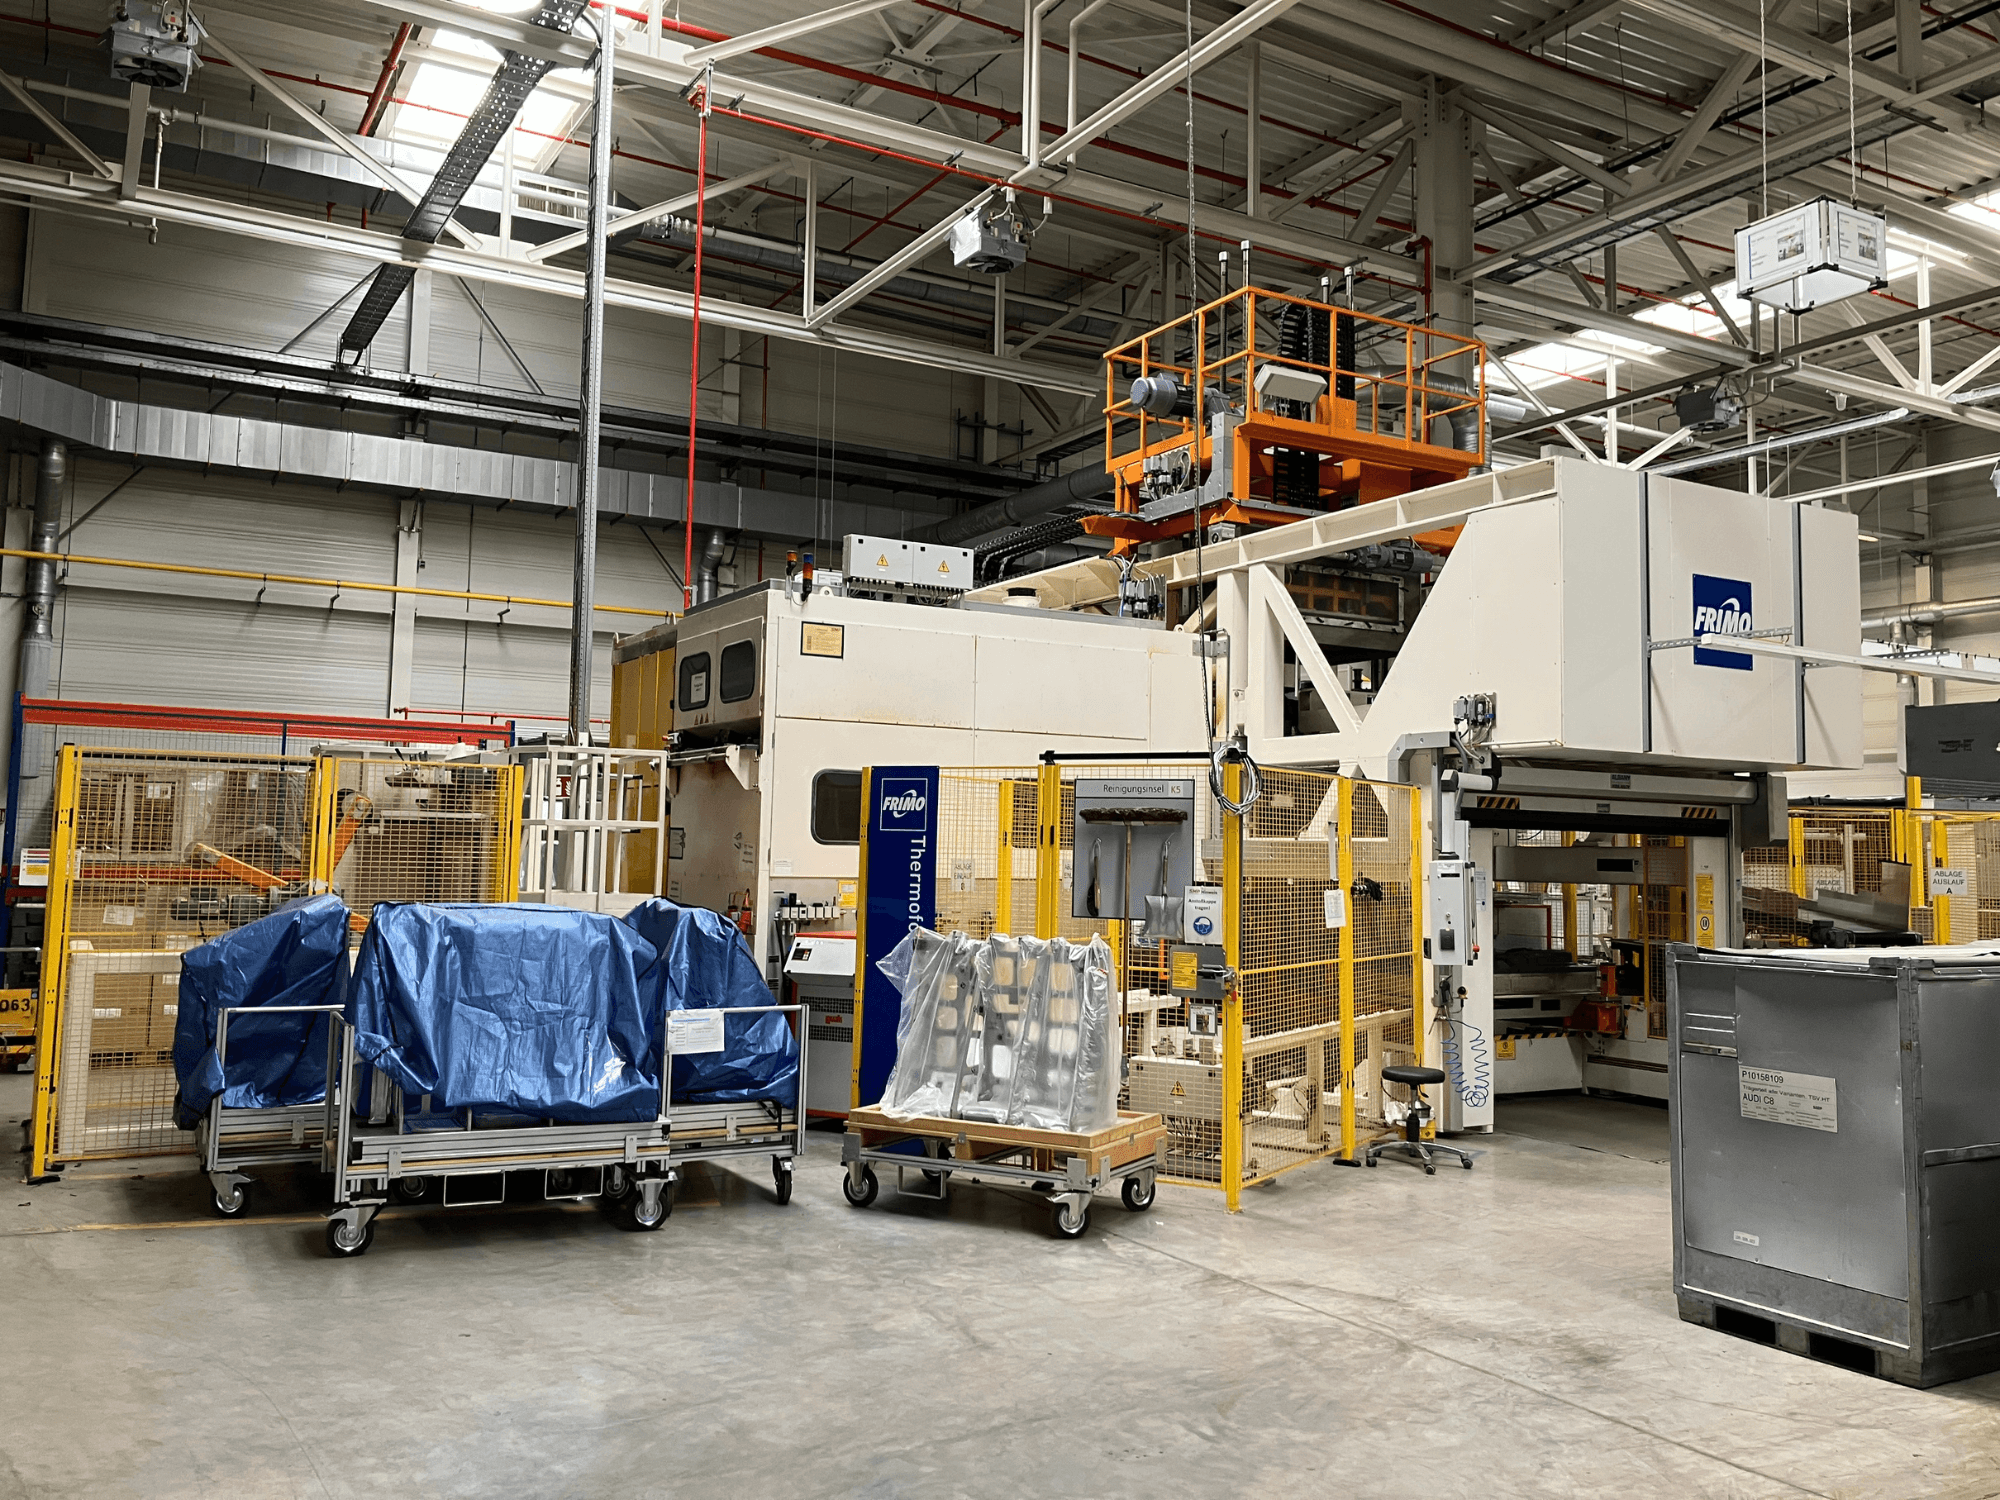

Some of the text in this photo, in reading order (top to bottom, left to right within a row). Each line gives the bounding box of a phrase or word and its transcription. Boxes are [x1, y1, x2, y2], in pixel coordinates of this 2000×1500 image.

[1694, 605, 1752, 634] FRIMO
[1103, 784, 1181, 795] Reinigungsinsel K5
[882, 796, 926, 812] FRIMO
[1934, 870, 1963, 878] ABLAGE
[1932, 878, 1966, 886] AUSLAUF
[1946, 887, 1953, 895] A
[0, 998, 31, 1012] 063
[1742, 1071, 1784, 1084] P10158109
[1743, 1093, 1775, 1106] AUDI C8
